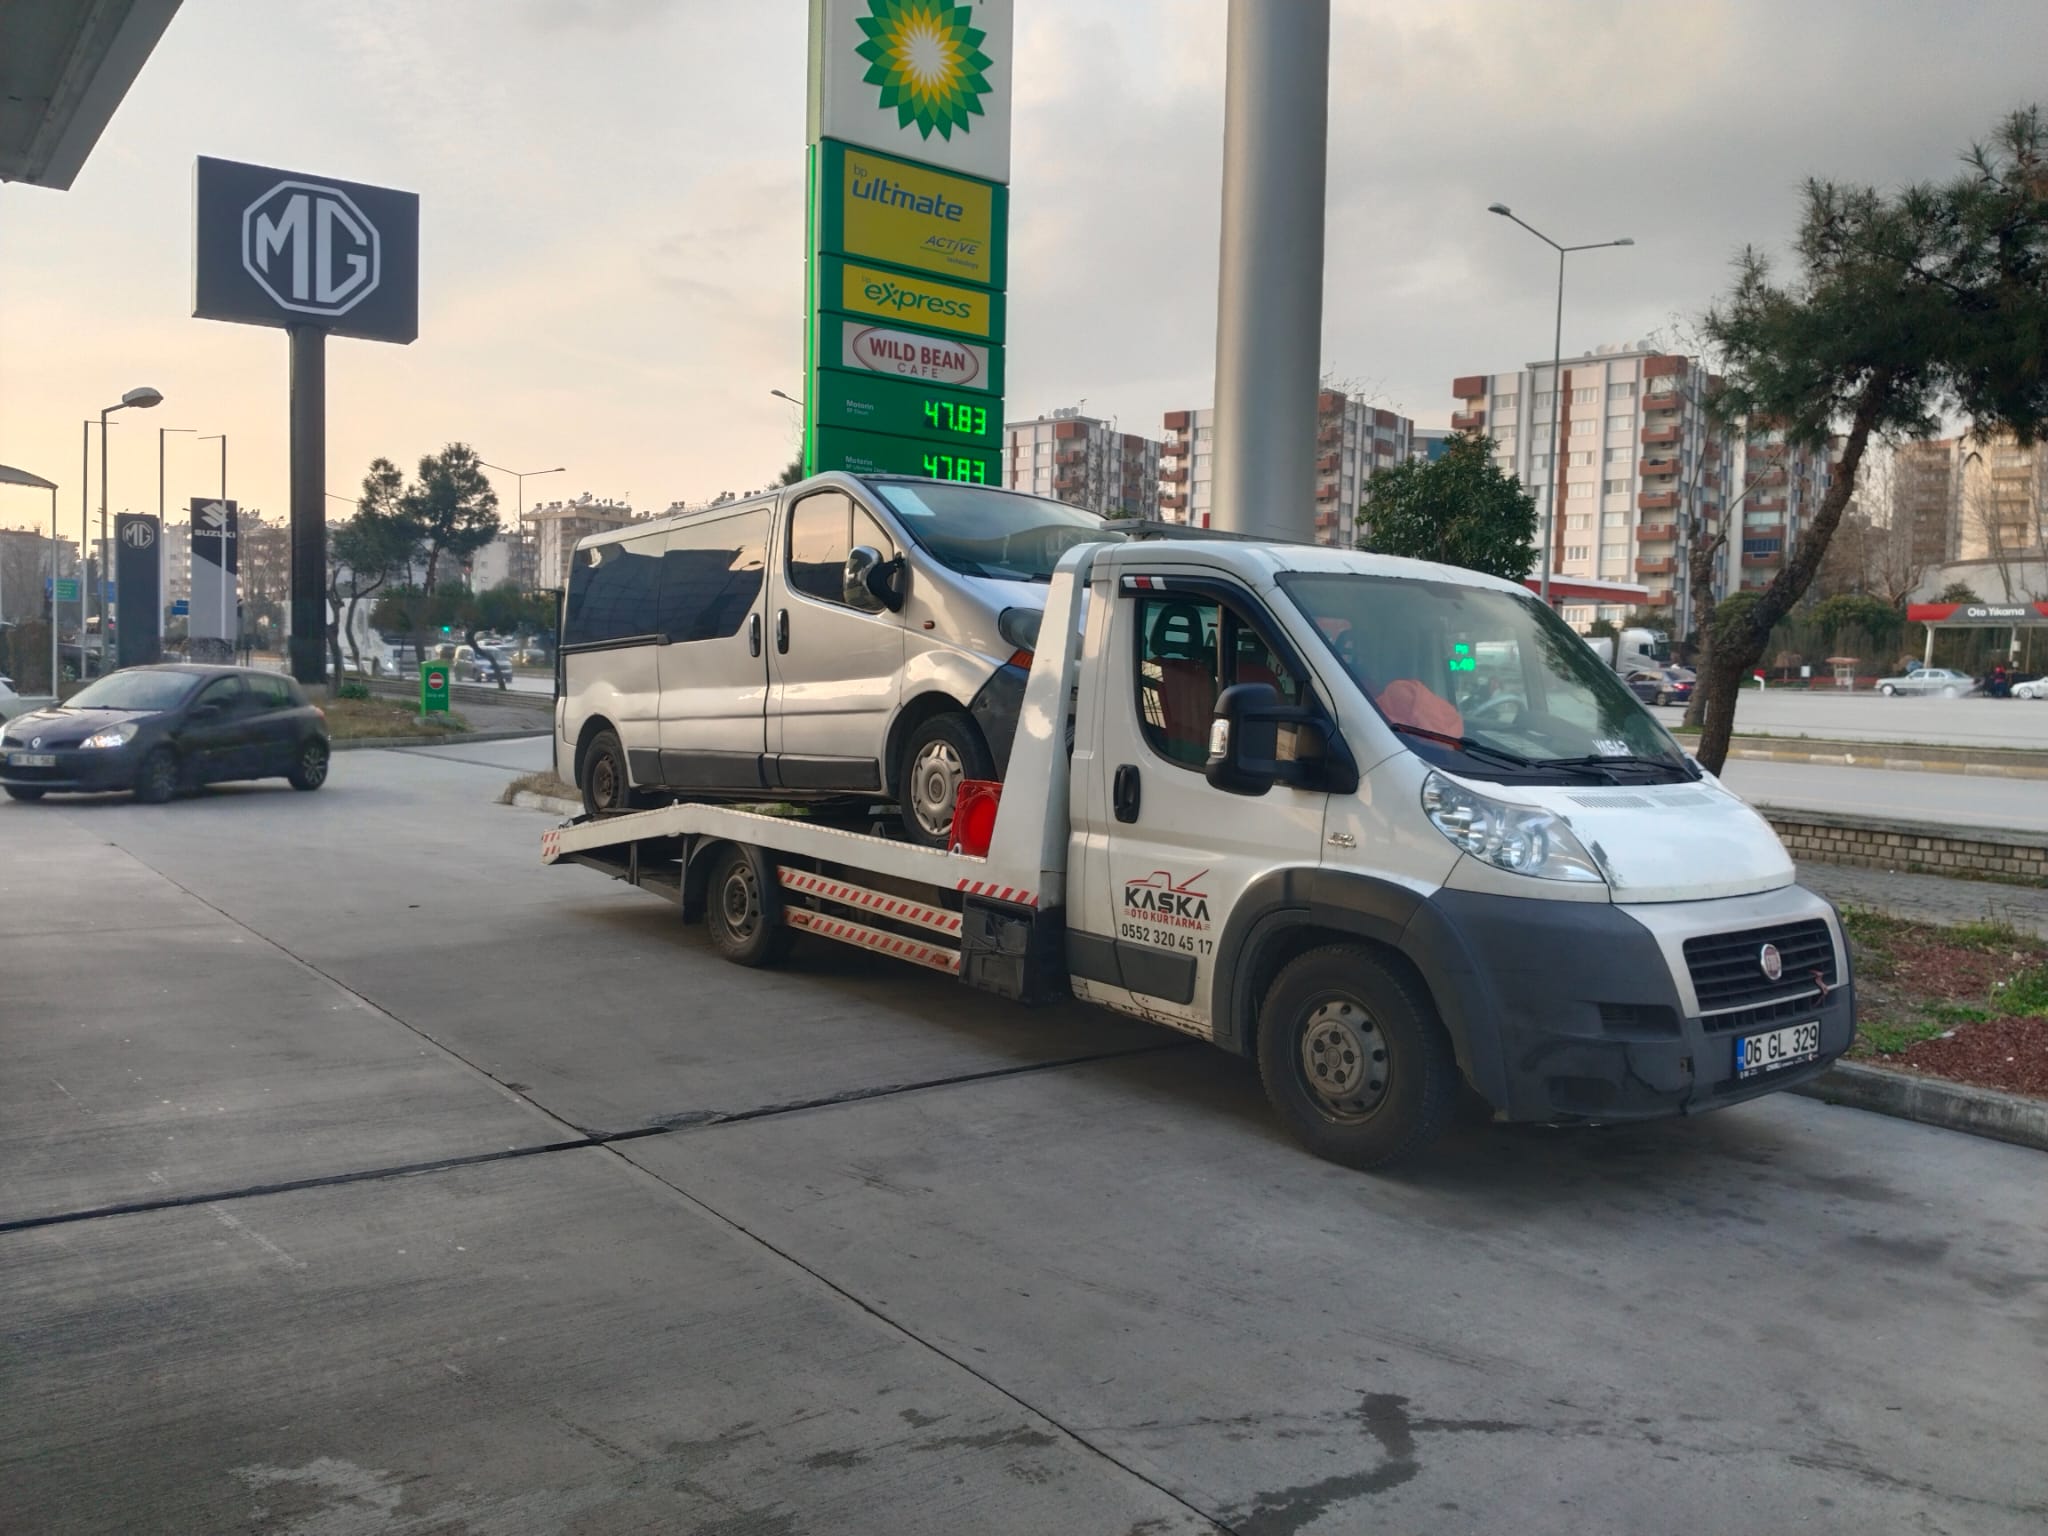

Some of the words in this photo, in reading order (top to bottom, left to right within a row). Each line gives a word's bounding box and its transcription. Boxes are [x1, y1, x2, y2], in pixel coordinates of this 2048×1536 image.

[854, 163, 868, 178] bp
[852, 178, 963, 222] ultimate
[255, 193, 368, 304] MG
[925, 235, 980, 255] ACTIVE
[863, 282, 972, 319] express
[869, 337, 916, 362] WILD
[921, 346, 966, 371] BEAN
[897, 362, 938, 378] CAFE
[924, 400, 987, 436] 47.83
[125, 524, 151, 547] MG
[1967, 607, 1987, 617] Oto
[1131, 908, 1148, 920] OTO
[1150, 912, 1202, 930] KURTARMA
[1121, 923, 1150, 942] 0552
[1153, 930, 1175, 947] 320
[1178, 936, 1194, 951] 45
[1198, 939, 1213, 955] 17
[1745, 1037, 1762, 1066] 06
[1768, 1032, 1787, 1059] GL
[1793, 1025, 1818, 1053] 329
